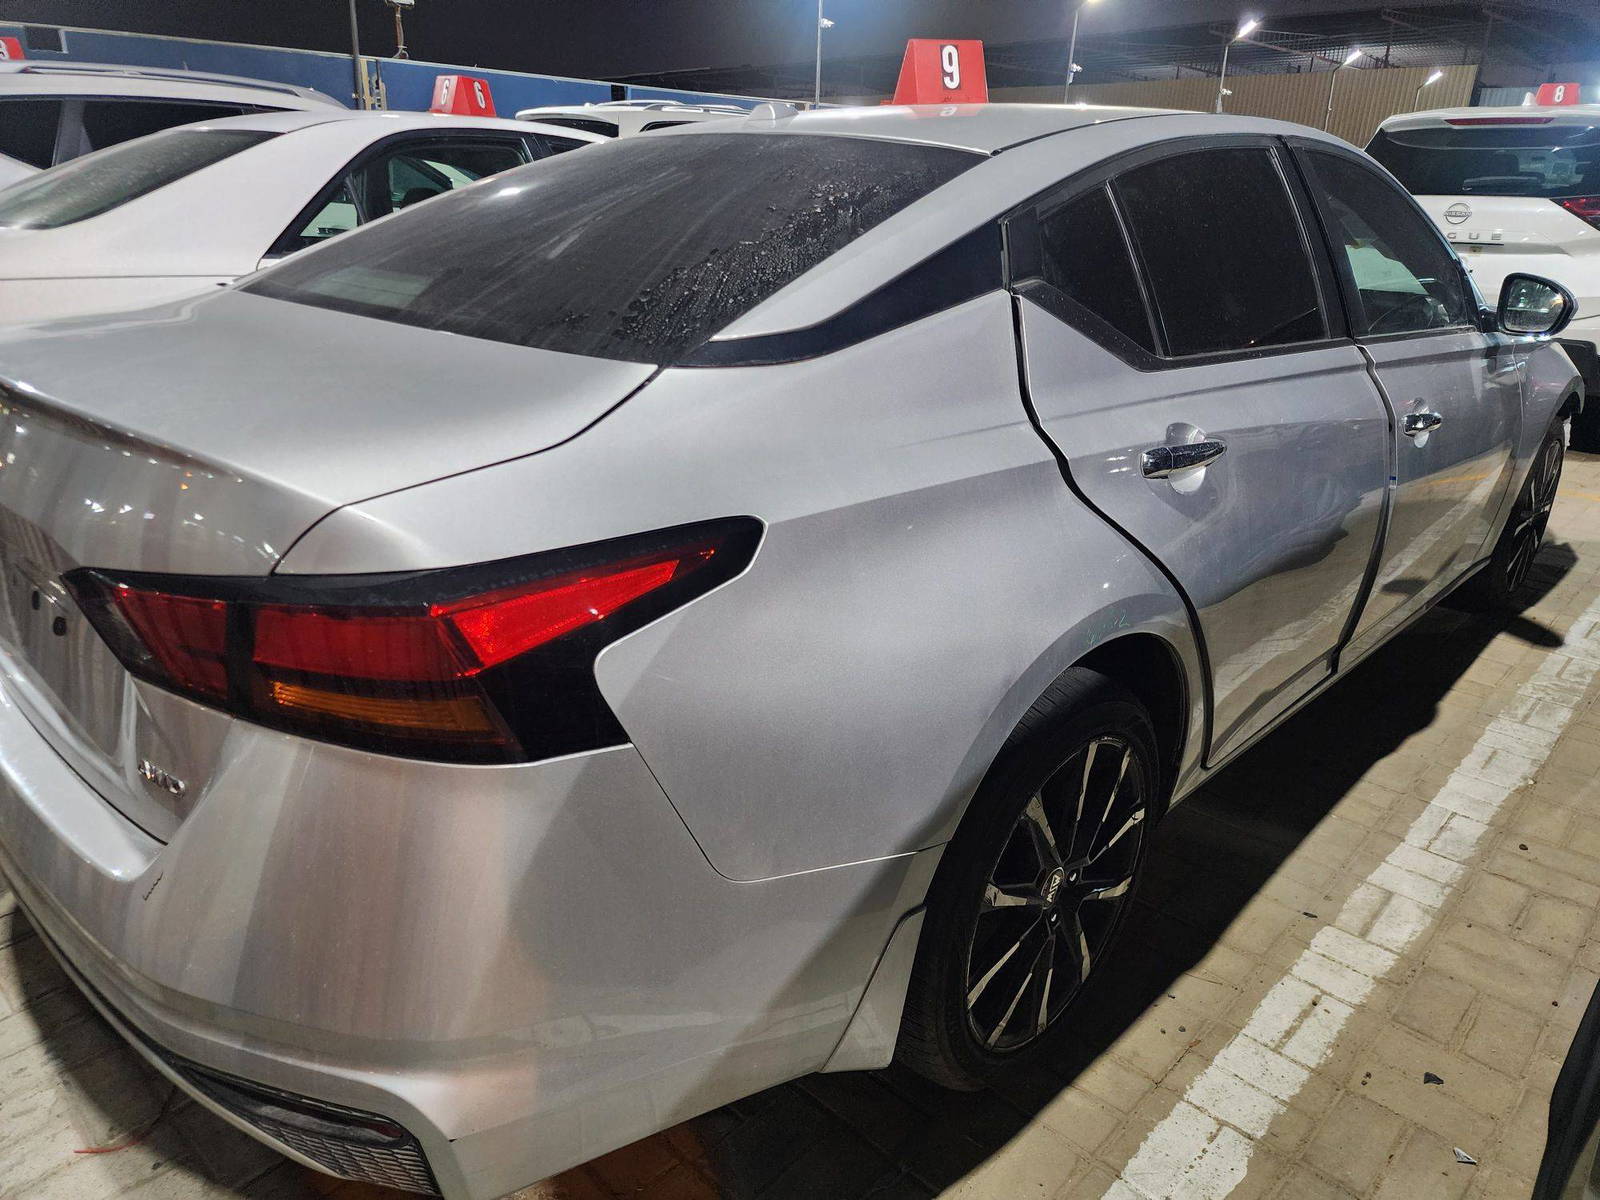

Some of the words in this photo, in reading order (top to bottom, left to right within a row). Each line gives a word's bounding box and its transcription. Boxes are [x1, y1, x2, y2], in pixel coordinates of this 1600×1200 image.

[942, 44, 960, 90] 9
[441, 79, 450, 105] 6
[473, 80, 486, 109] 6
[1555, 85, 1565, 103] 8
